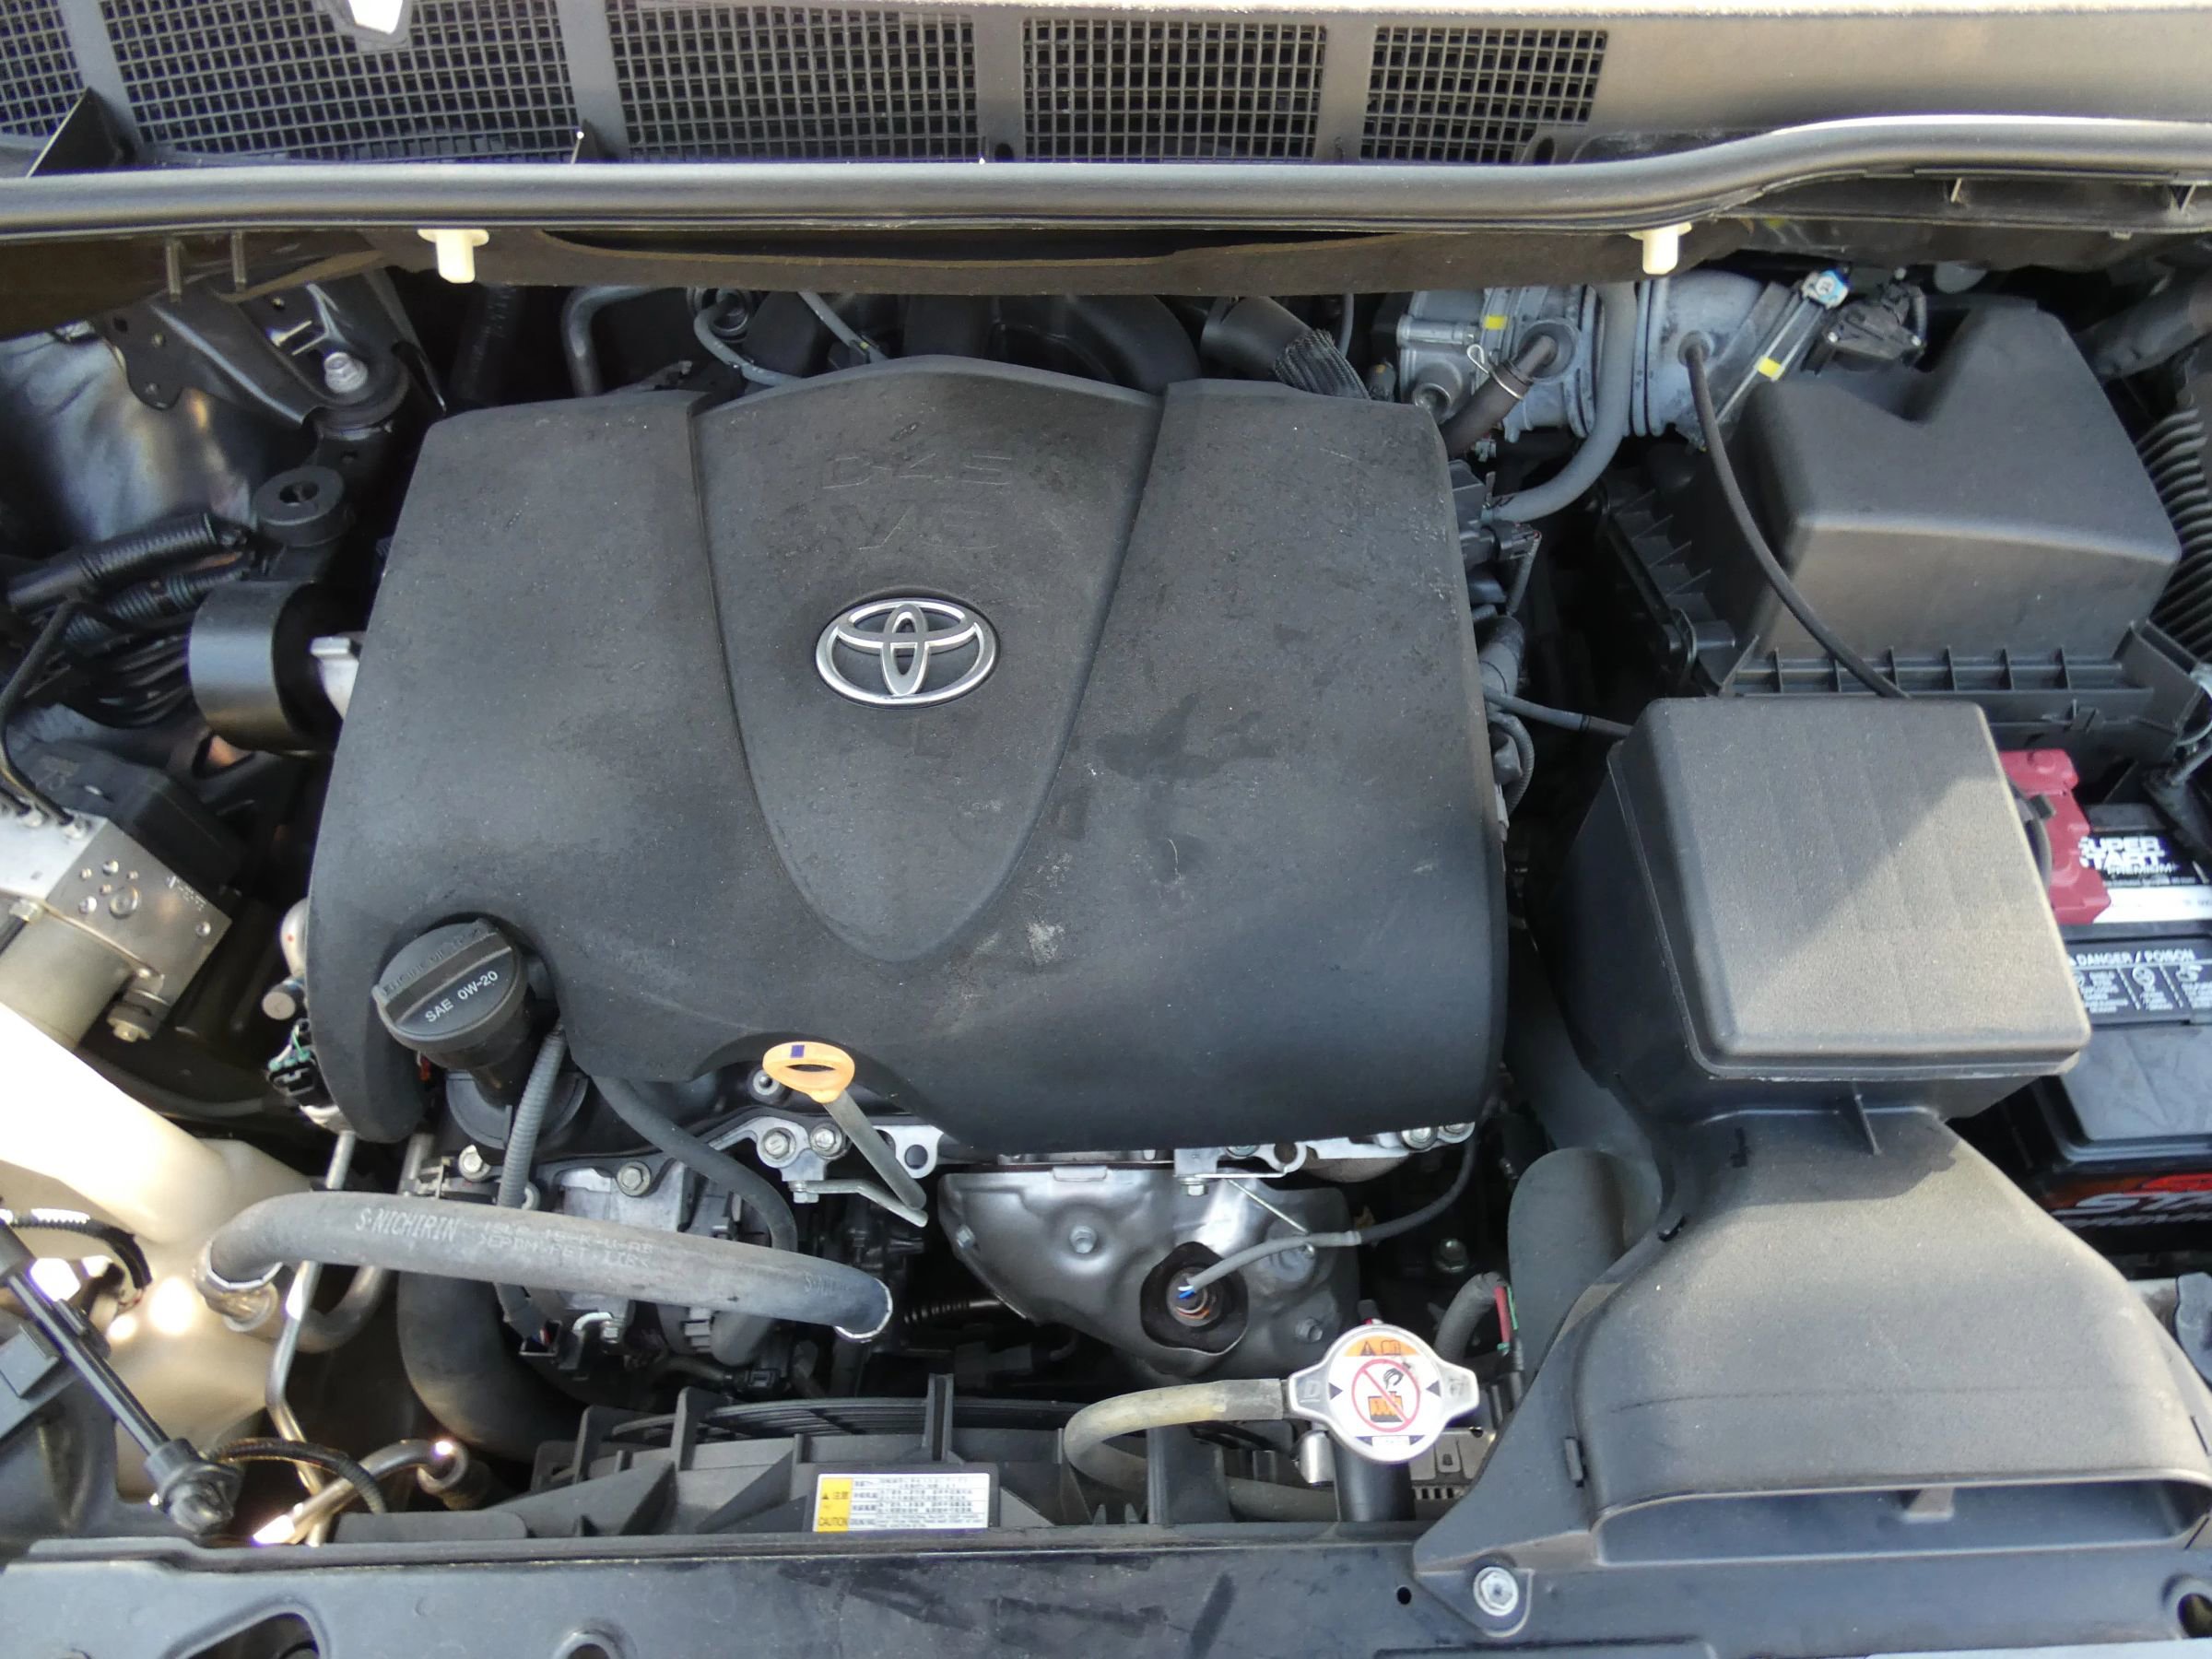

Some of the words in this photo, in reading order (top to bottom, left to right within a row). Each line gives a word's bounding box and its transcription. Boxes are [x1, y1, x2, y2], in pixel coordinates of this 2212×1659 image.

[2077, 952, 2134, 967] DANGER
[2144, 947, 2195, 963] POISON
[424, 998, 454, 1023] SAE
[457, 970, 499, 1001] 0W-20
